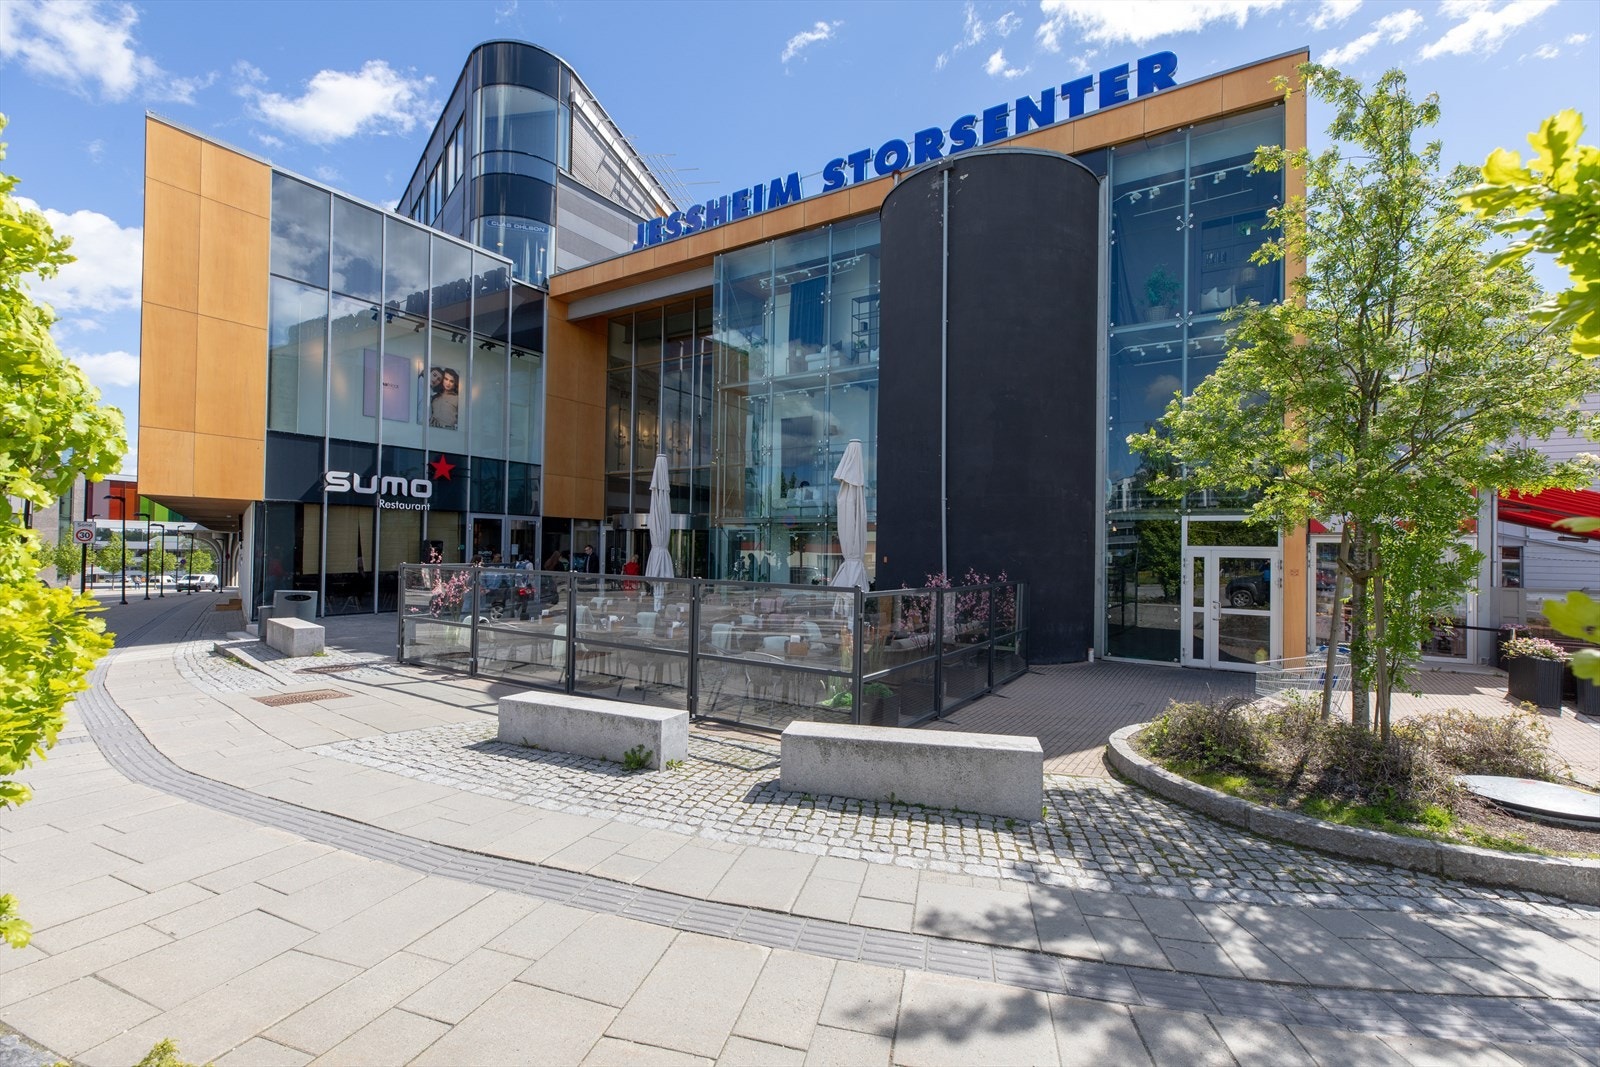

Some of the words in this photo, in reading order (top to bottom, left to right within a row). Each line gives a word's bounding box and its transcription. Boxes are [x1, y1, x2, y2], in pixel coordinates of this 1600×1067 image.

[632, 171, 804, 250] JESSHEIM
[822, 51, 1179, 193] STORSENTER
[491, 220, 512, 228] CLAS
[513, 223, 545, 232] OHLSON
[379, 499, 431, 511] Restaurant
